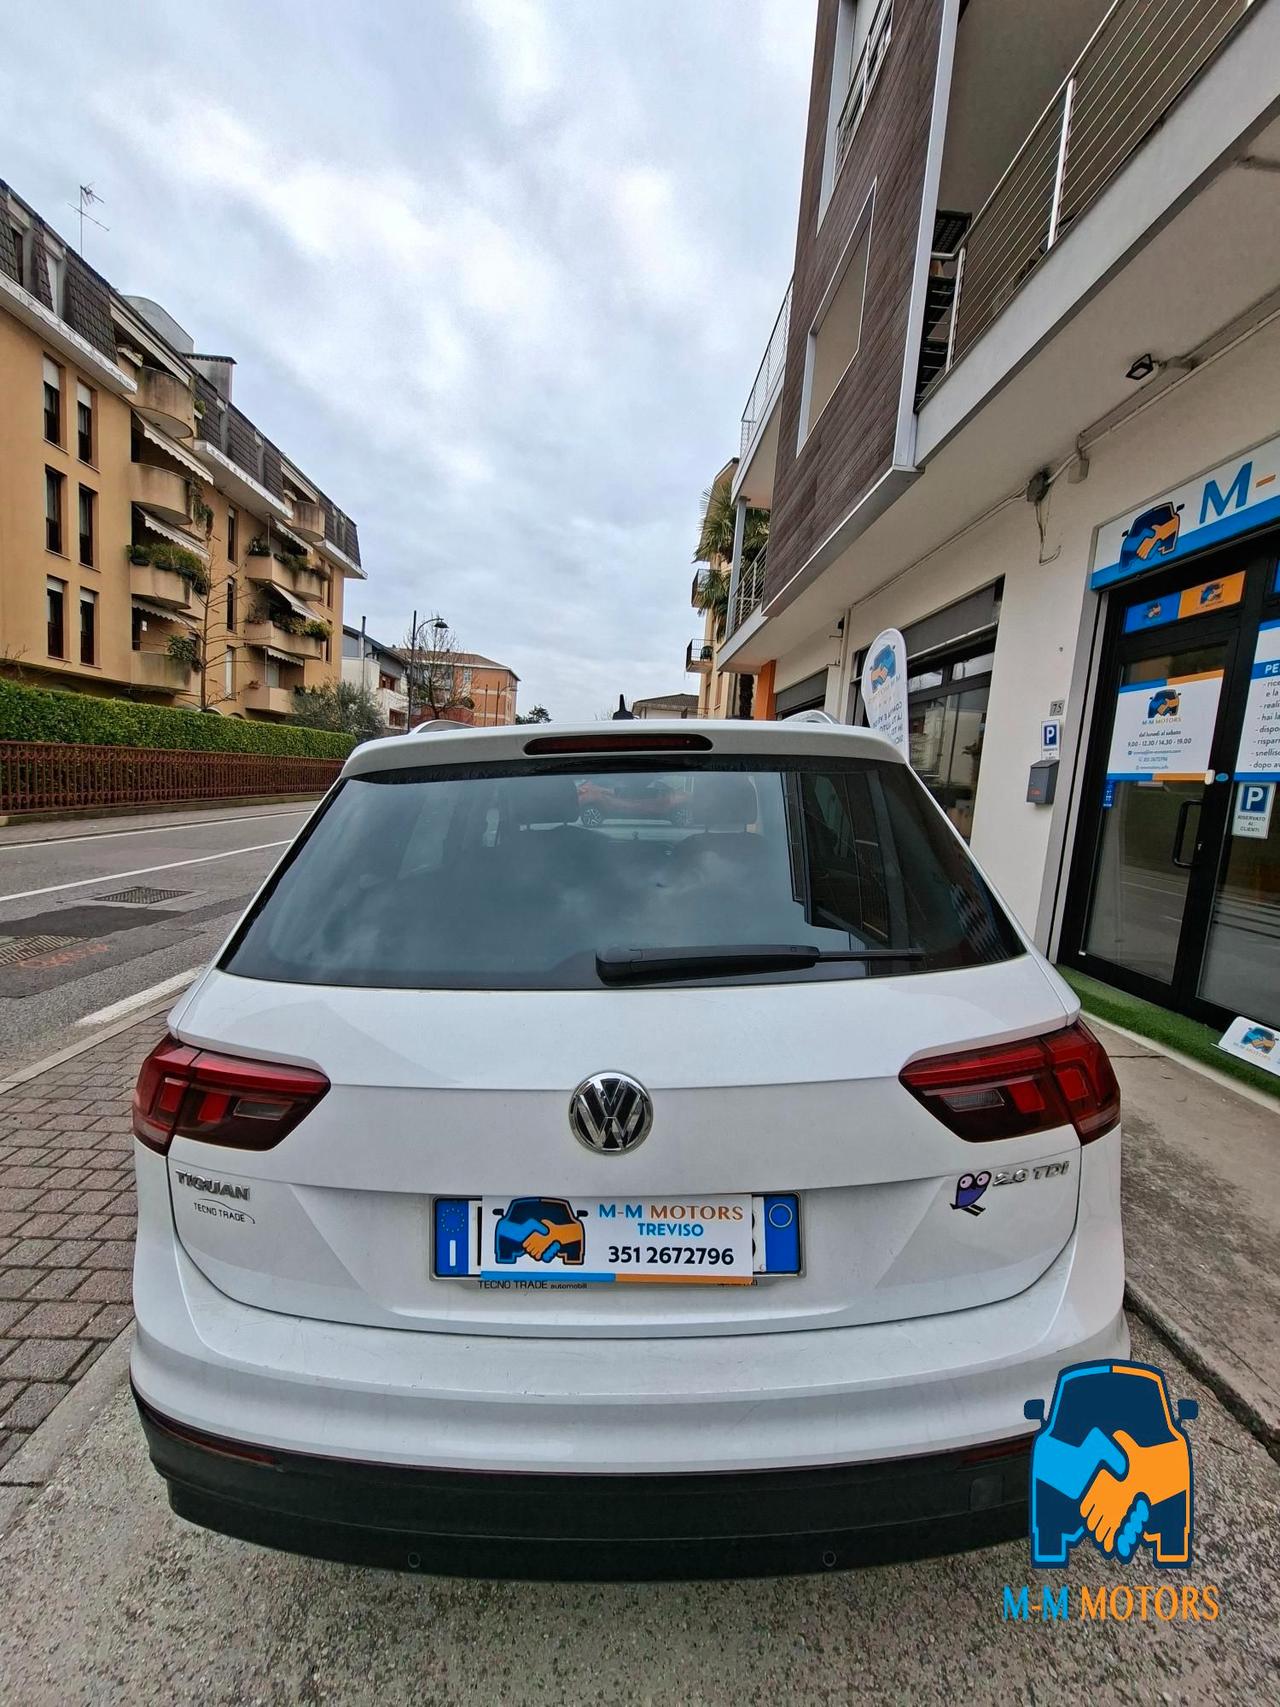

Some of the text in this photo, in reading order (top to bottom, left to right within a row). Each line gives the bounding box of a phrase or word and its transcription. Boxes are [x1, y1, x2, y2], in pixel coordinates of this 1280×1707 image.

[1264, 663, 1280, 674] PE
[1052, 703, 1063, 713] 75
[1046, 726, 1055, 744] P
[1253, 760, 1272, 771] dopo
[1246, 786, 1264, 810] P
[1032, 1160, 1070, 1180] TDI
[175, 1169, 251, 1201] TIGUAN
[193, 1202, 247, 1223] TECNO TRADE
[598, 1203, 744, 1221] M-M MOTORS
[637, 1223, 704, 1237] TREVISO
[608, 1245, 735, 1265] 351 2672796
[478, 1280, 588, 1290] TECNO TRADE automobili
